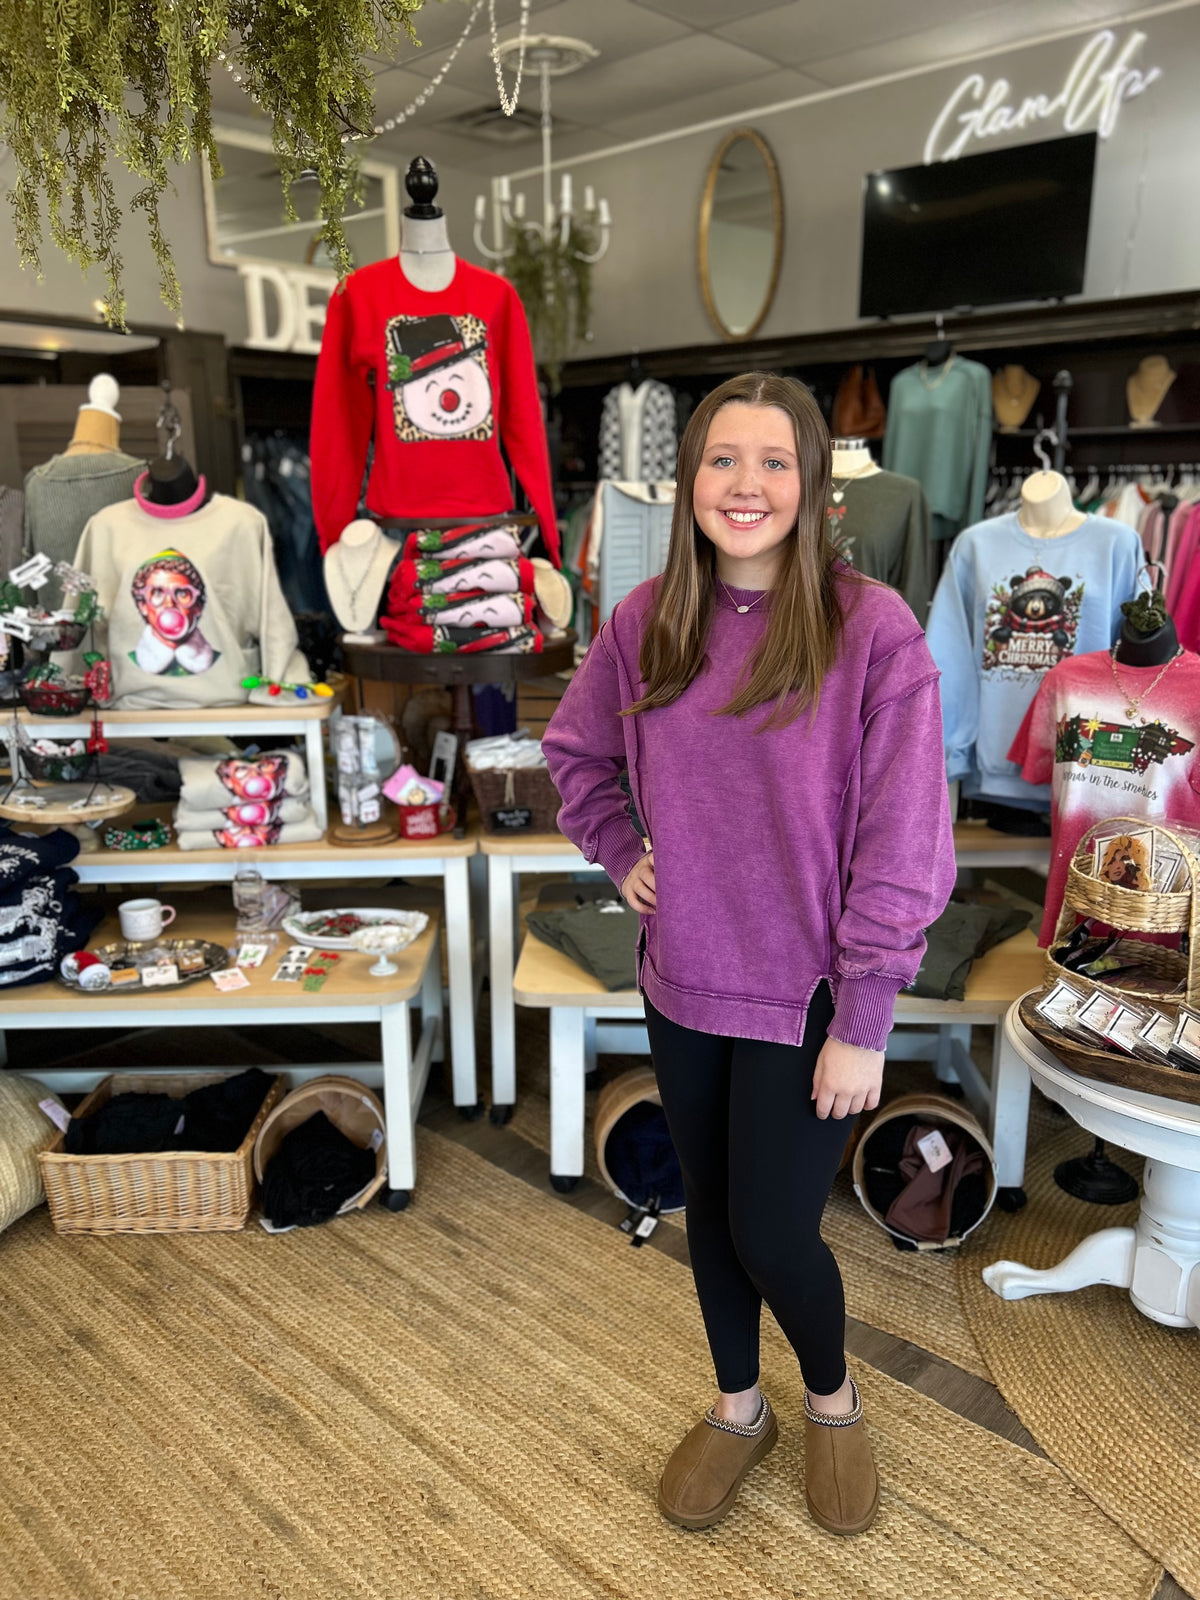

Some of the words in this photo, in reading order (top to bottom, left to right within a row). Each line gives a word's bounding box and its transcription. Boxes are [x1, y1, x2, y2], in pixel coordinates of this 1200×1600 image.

[923, 73, 1063, 165] Glam
[1008, 638, 1053, 653] MERRY
[998, 651, 1057, 666] CHRISTMAS
[1089, 772, 1102, 787] in
[1102, 775, 1121, 790] the
